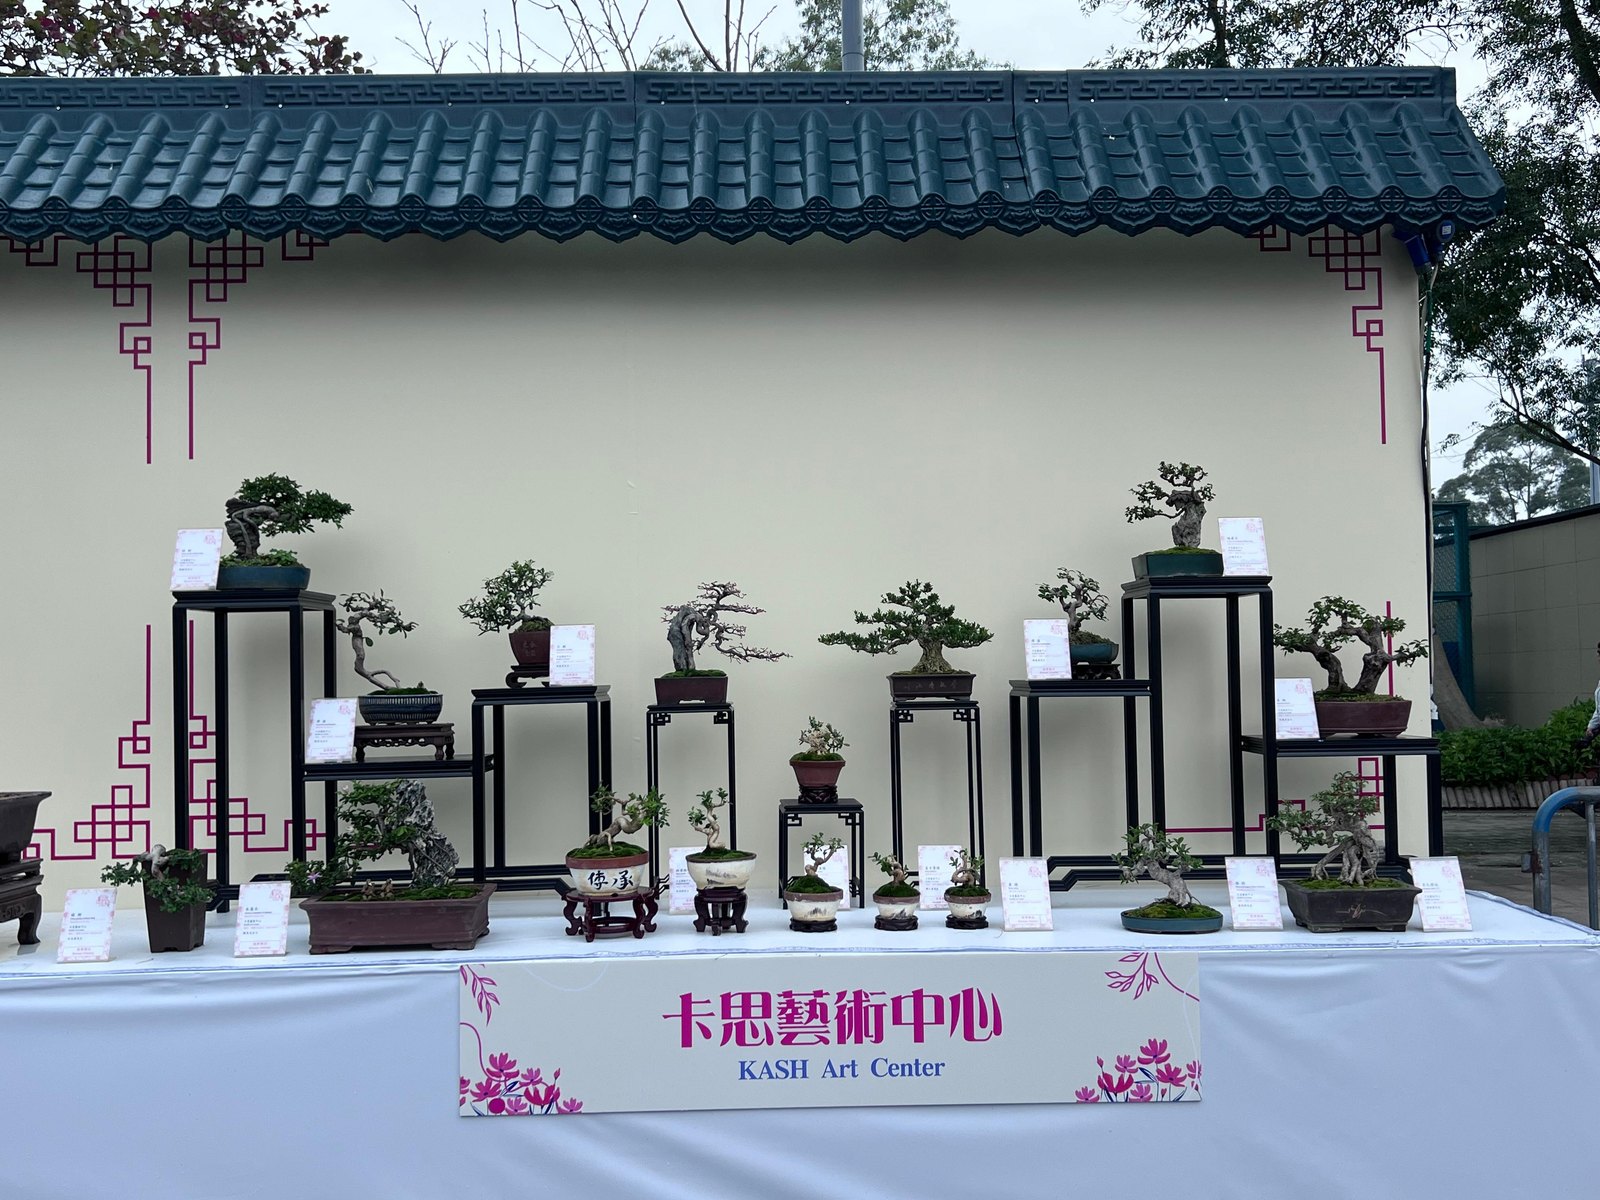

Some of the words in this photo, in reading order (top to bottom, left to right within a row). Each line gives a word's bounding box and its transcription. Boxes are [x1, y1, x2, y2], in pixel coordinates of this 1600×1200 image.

[663, 987, 1003, 1048] 卡思藝術中心
[738, 1059, 809, 1081] KASH
[821, 1059, 858, 1079] Art
[870, 1057, 946, 1078] Center
